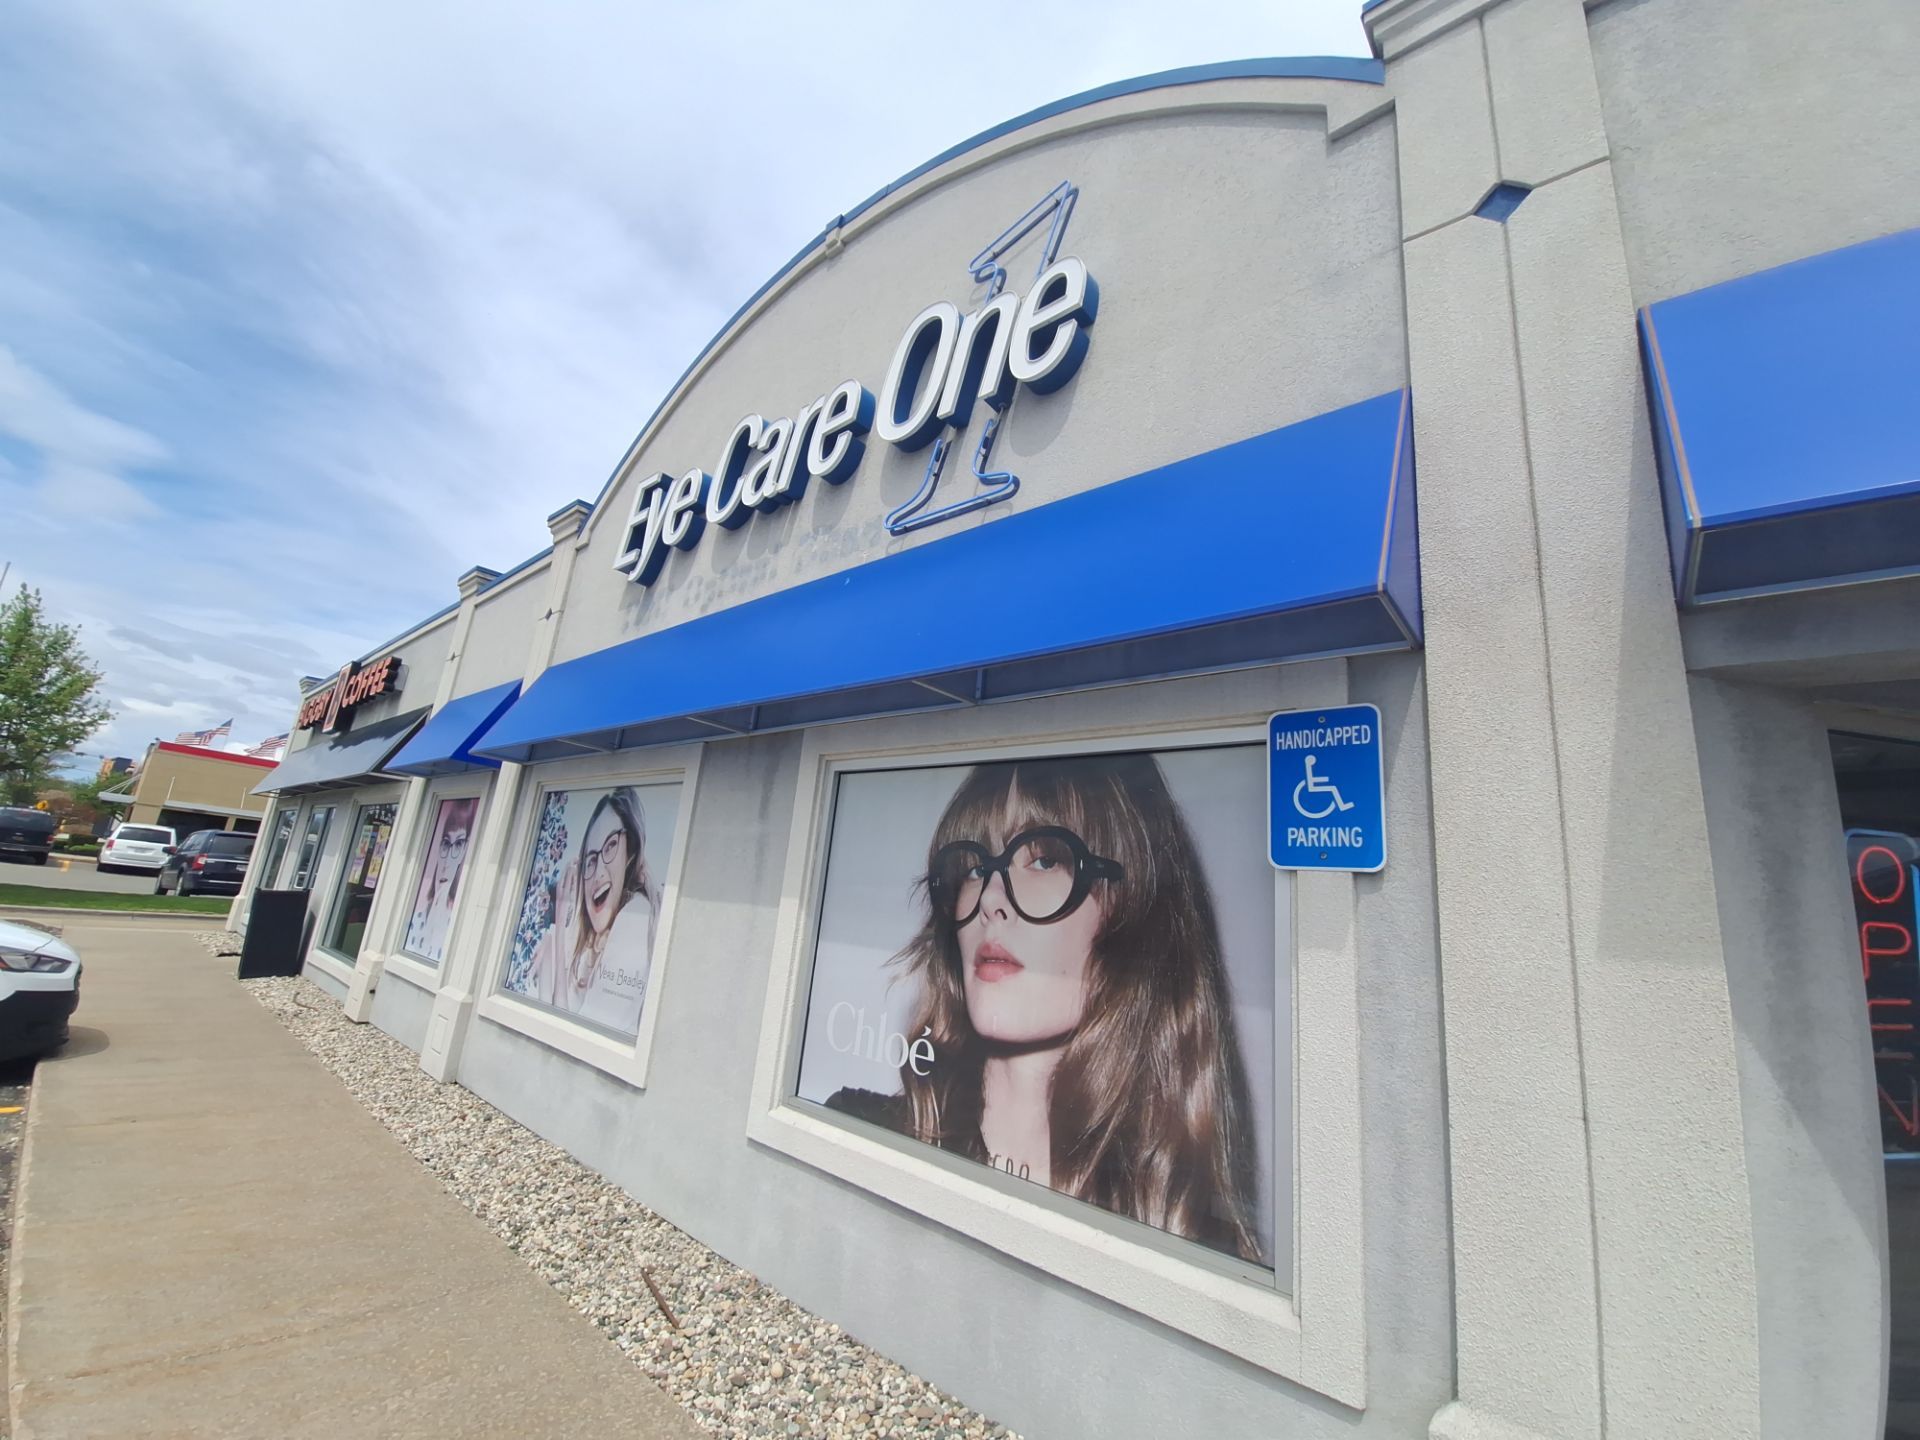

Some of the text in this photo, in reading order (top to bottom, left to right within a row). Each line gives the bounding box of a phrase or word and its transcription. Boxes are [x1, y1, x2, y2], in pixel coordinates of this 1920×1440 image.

[613, 255, 1093, 584] Eye Care One
[342, 656, 393, 708] COFFEE
[1276, 724, 1371, 751] HANDICAPPED
[1287, 826, 1363, 848] PARKING
[1857, 845, 1919, 1136] OPEN
[826, 1001, 936, 1076] Chloé
